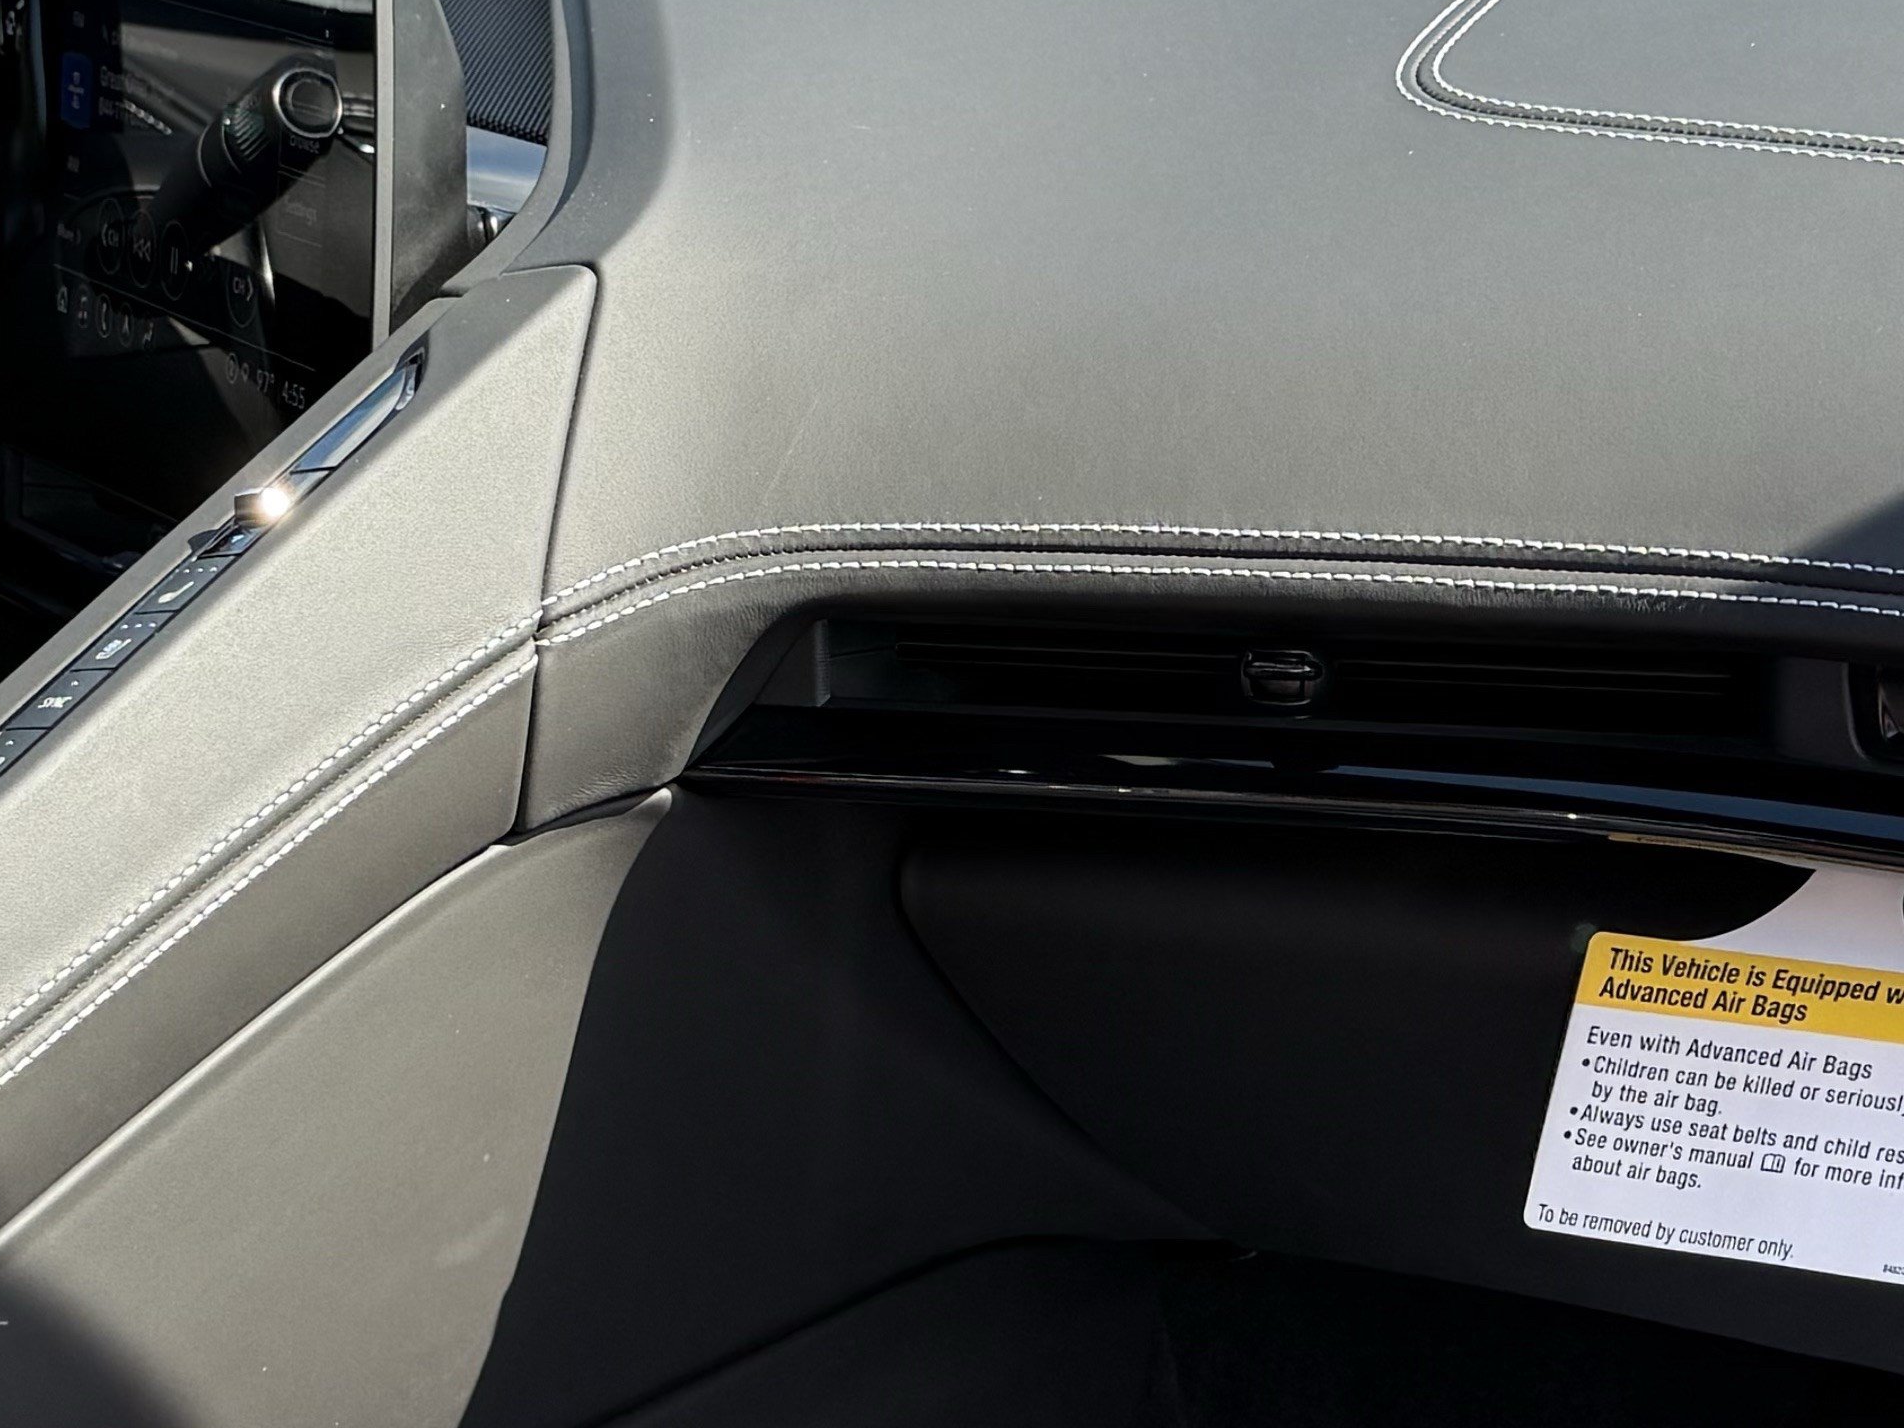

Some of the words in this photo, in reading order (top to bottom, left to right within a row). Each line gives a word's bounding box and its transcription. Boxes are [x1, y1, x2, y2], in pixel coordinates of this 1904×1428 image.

[1598, 976, 1709, 1009] Advanced
[1711, 990, 1746, 1014] Air
[1751, 994, 1808, 1025] Bags
[1610, 947, 1654, 973] This
[1662, 953, 1741, 984] Vehicle
[1745, 964, 1767, 987] is
[1771, 968, 1881, 1002] Equipped
[1586, 1025, 1633, 1049] Even
[1640, 1034, 1681, 1055] with
[1685, 1038, 1783, 1068] Advanced
[1786, 1050, 1817, 1071] Air
[1822, 1055, 1873, 1082] Bags
[1593, 1055, 1669, 1082] Children
[1675, 1070, 1708, 1087] can
[1714, 1071, 1737, 1091] be
[1742, 1074, 1795, 1098] killed
[1799, 1086, 1821, 1101] or
[1591, 1080, 1614, 1103] by
[1619, 1085, 1648, 1104] the
[1653, 1089, 1679, 1108] air
[1684, 1093, 1721, 1118] bag.
[1574, 1127, 1608, 1149] See
[1612, 1137, 1683, 1160] owner's
[1688, 1148, 1754, 1169] manual
[1794, 1157, 1820, 1178] for
[1824, 1165, 1873, 1186] more
[1579, 1104, 1645, 1132] Always
[1650, 1117, 1683, 1135] use
[1688, 1122, 1728, 1141] seat
[1732, 1124, 1777, 1147] belts
[1782, 1134, 1819, 1152] and
[1824, 1138, 1871, 1159] child
[1572, 1154, 1622, 1176] about
[1626, 1164, 1652, 1181] air
[1655, 1165, 1701, 1190] bags.
[1537, 1203, 1554, 1223] To
[1558, 1208, 1579, 1227] be
[1582, 1214, 1653, 1238] removed
[1655, 1222, 1676, 1245] by
[1679, 1229, 1755, 1252] customer
[1757, 1239, 1793, 1261] only.
